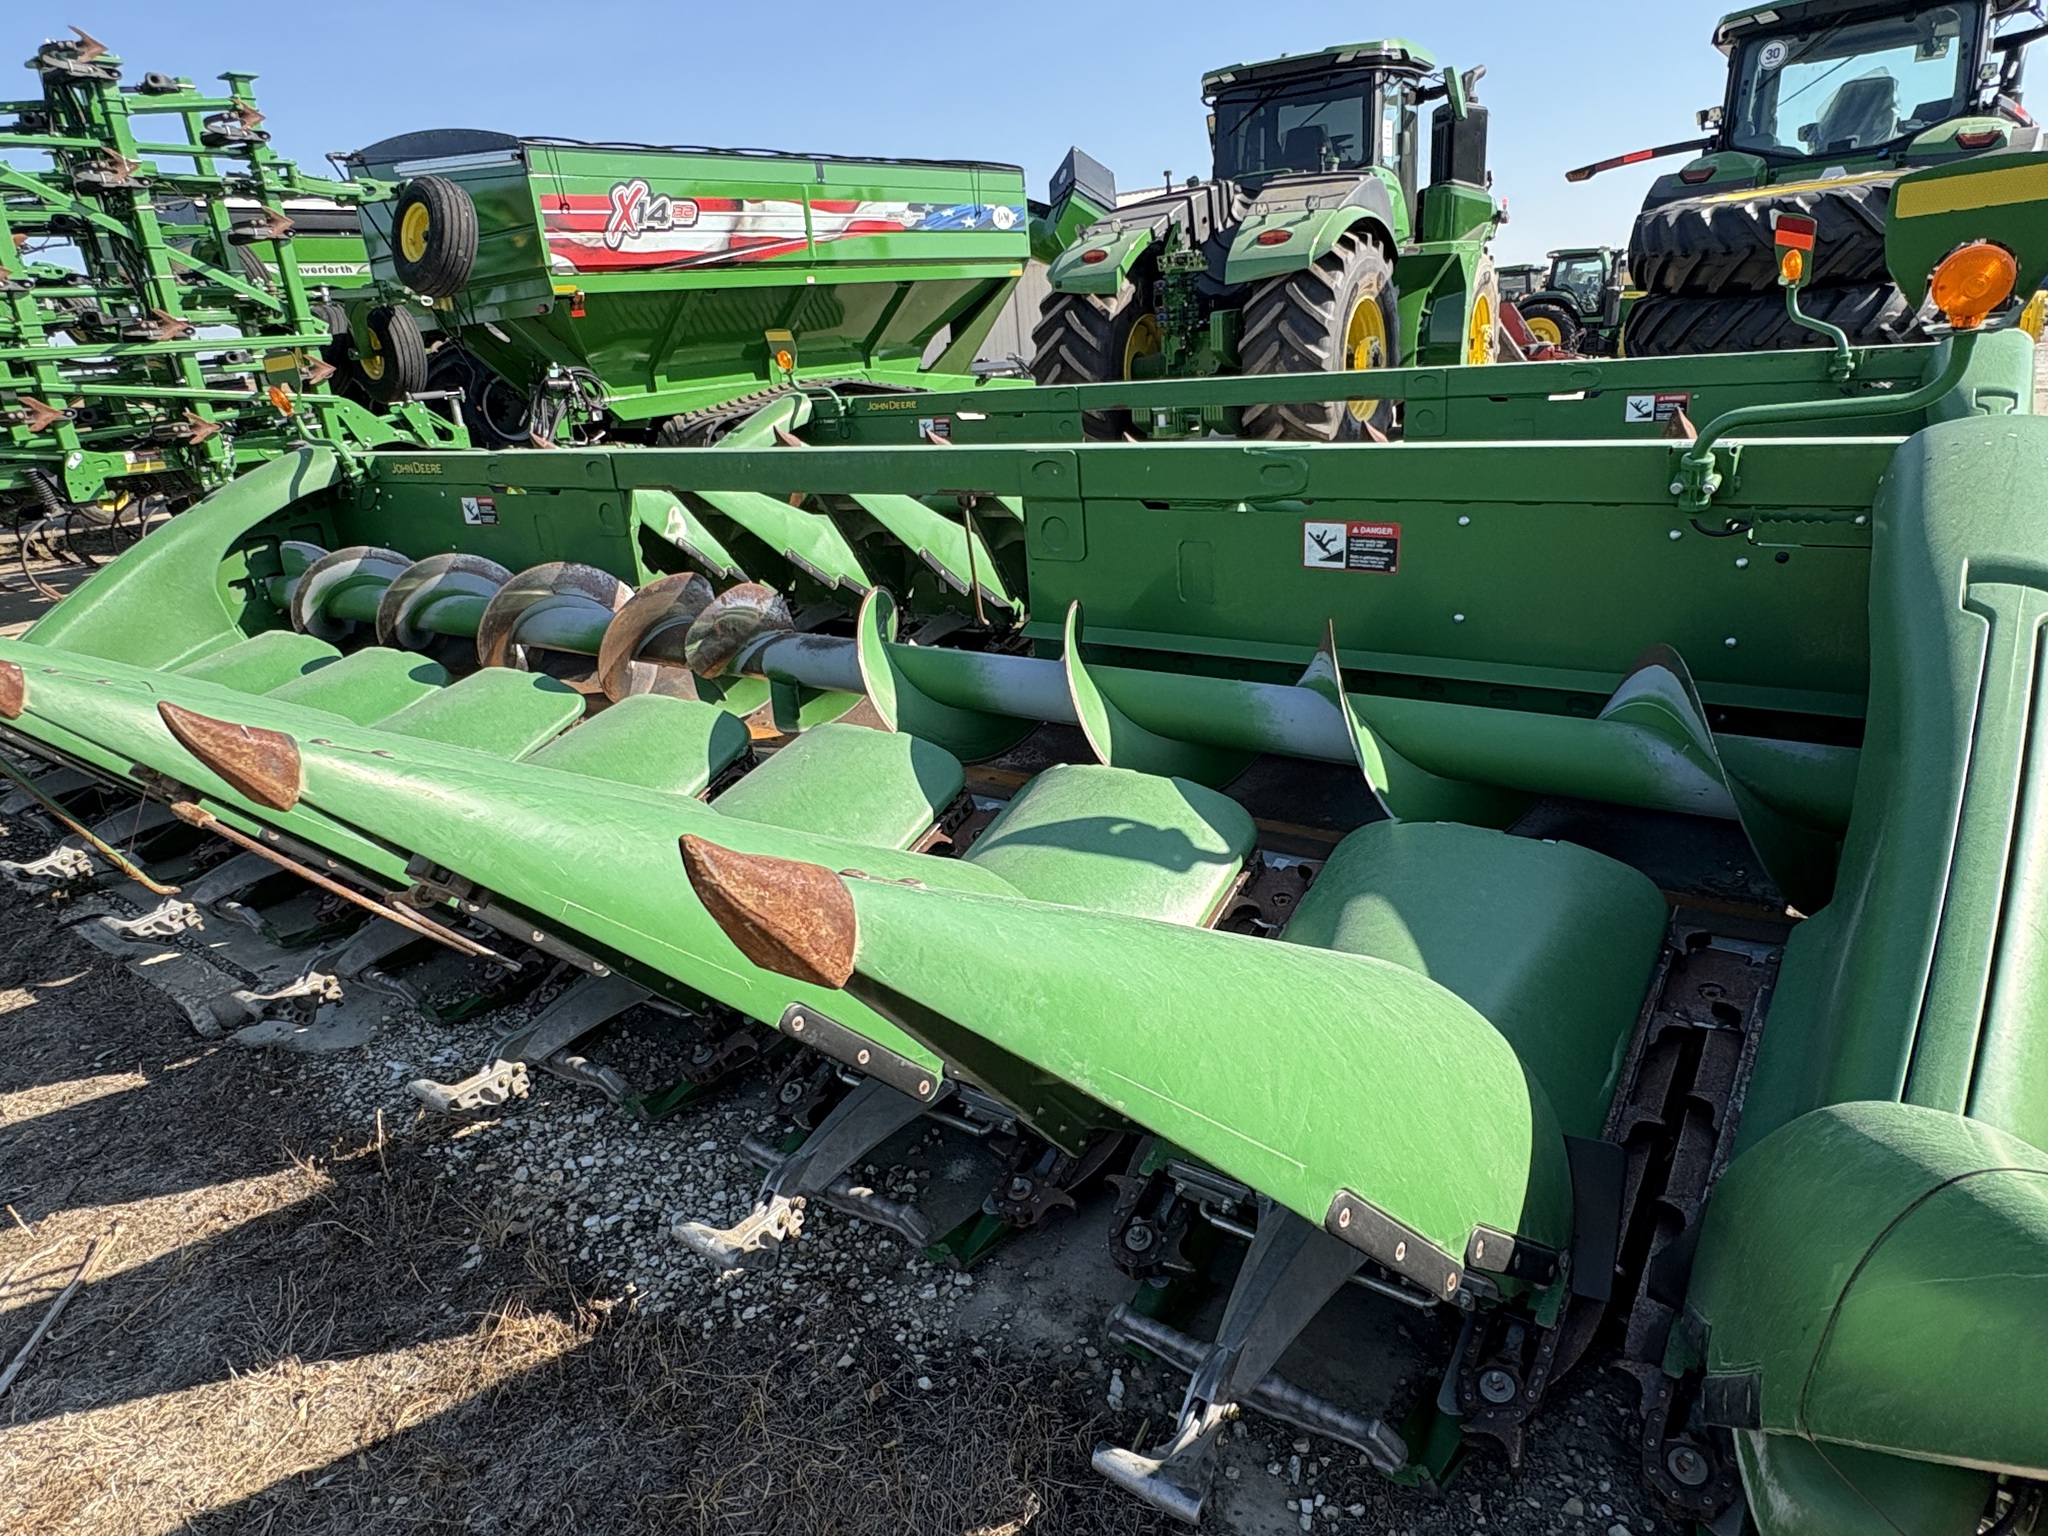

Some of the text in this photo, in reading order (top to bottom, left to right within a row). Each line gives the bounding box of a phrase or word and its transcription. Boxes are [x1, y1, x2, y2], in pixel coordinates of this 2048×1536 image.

[1766, 47, 1780, 60] 30
[298, 265, 353, 274] nverferth
[1360, 526, 1393, 535] DANGER
